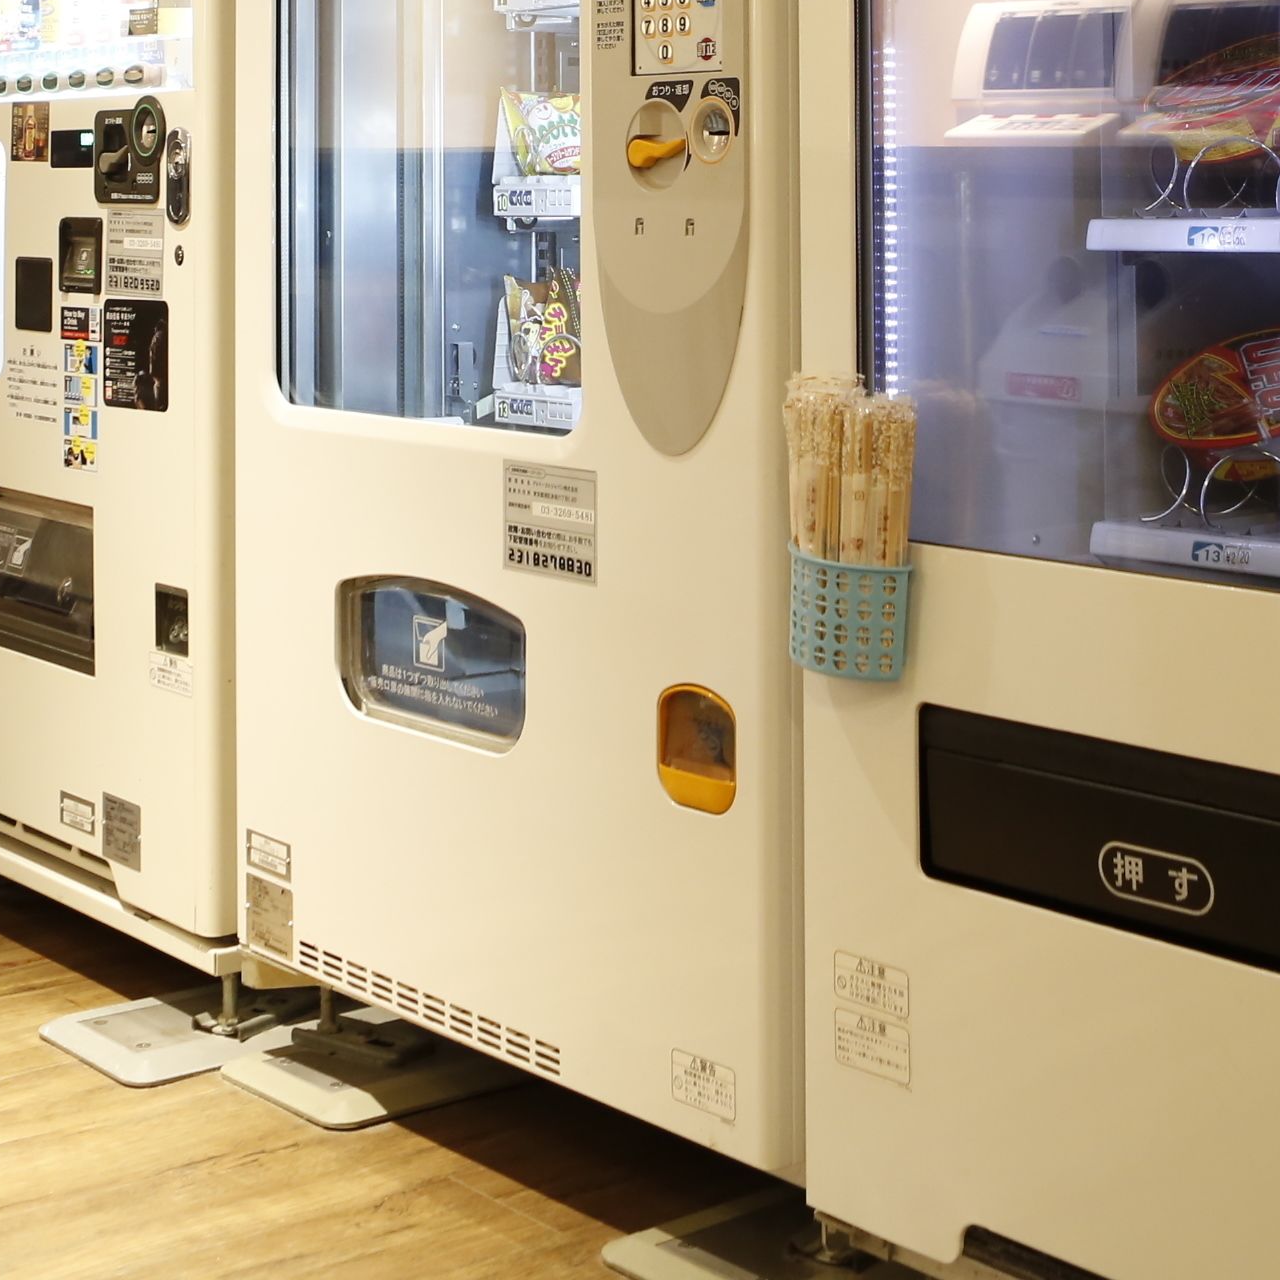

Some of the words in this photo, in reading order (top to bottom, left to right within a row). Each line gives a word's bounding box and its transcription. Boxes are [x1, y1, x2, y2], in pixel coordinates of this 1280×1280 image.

[644, 20, 651, 34] 7
[661, 18, 669, 33] 8
[678, 17, 686, 32] 9
[662, 45, 669, 60] 0
[1204, 549, 1220, 562] 13
